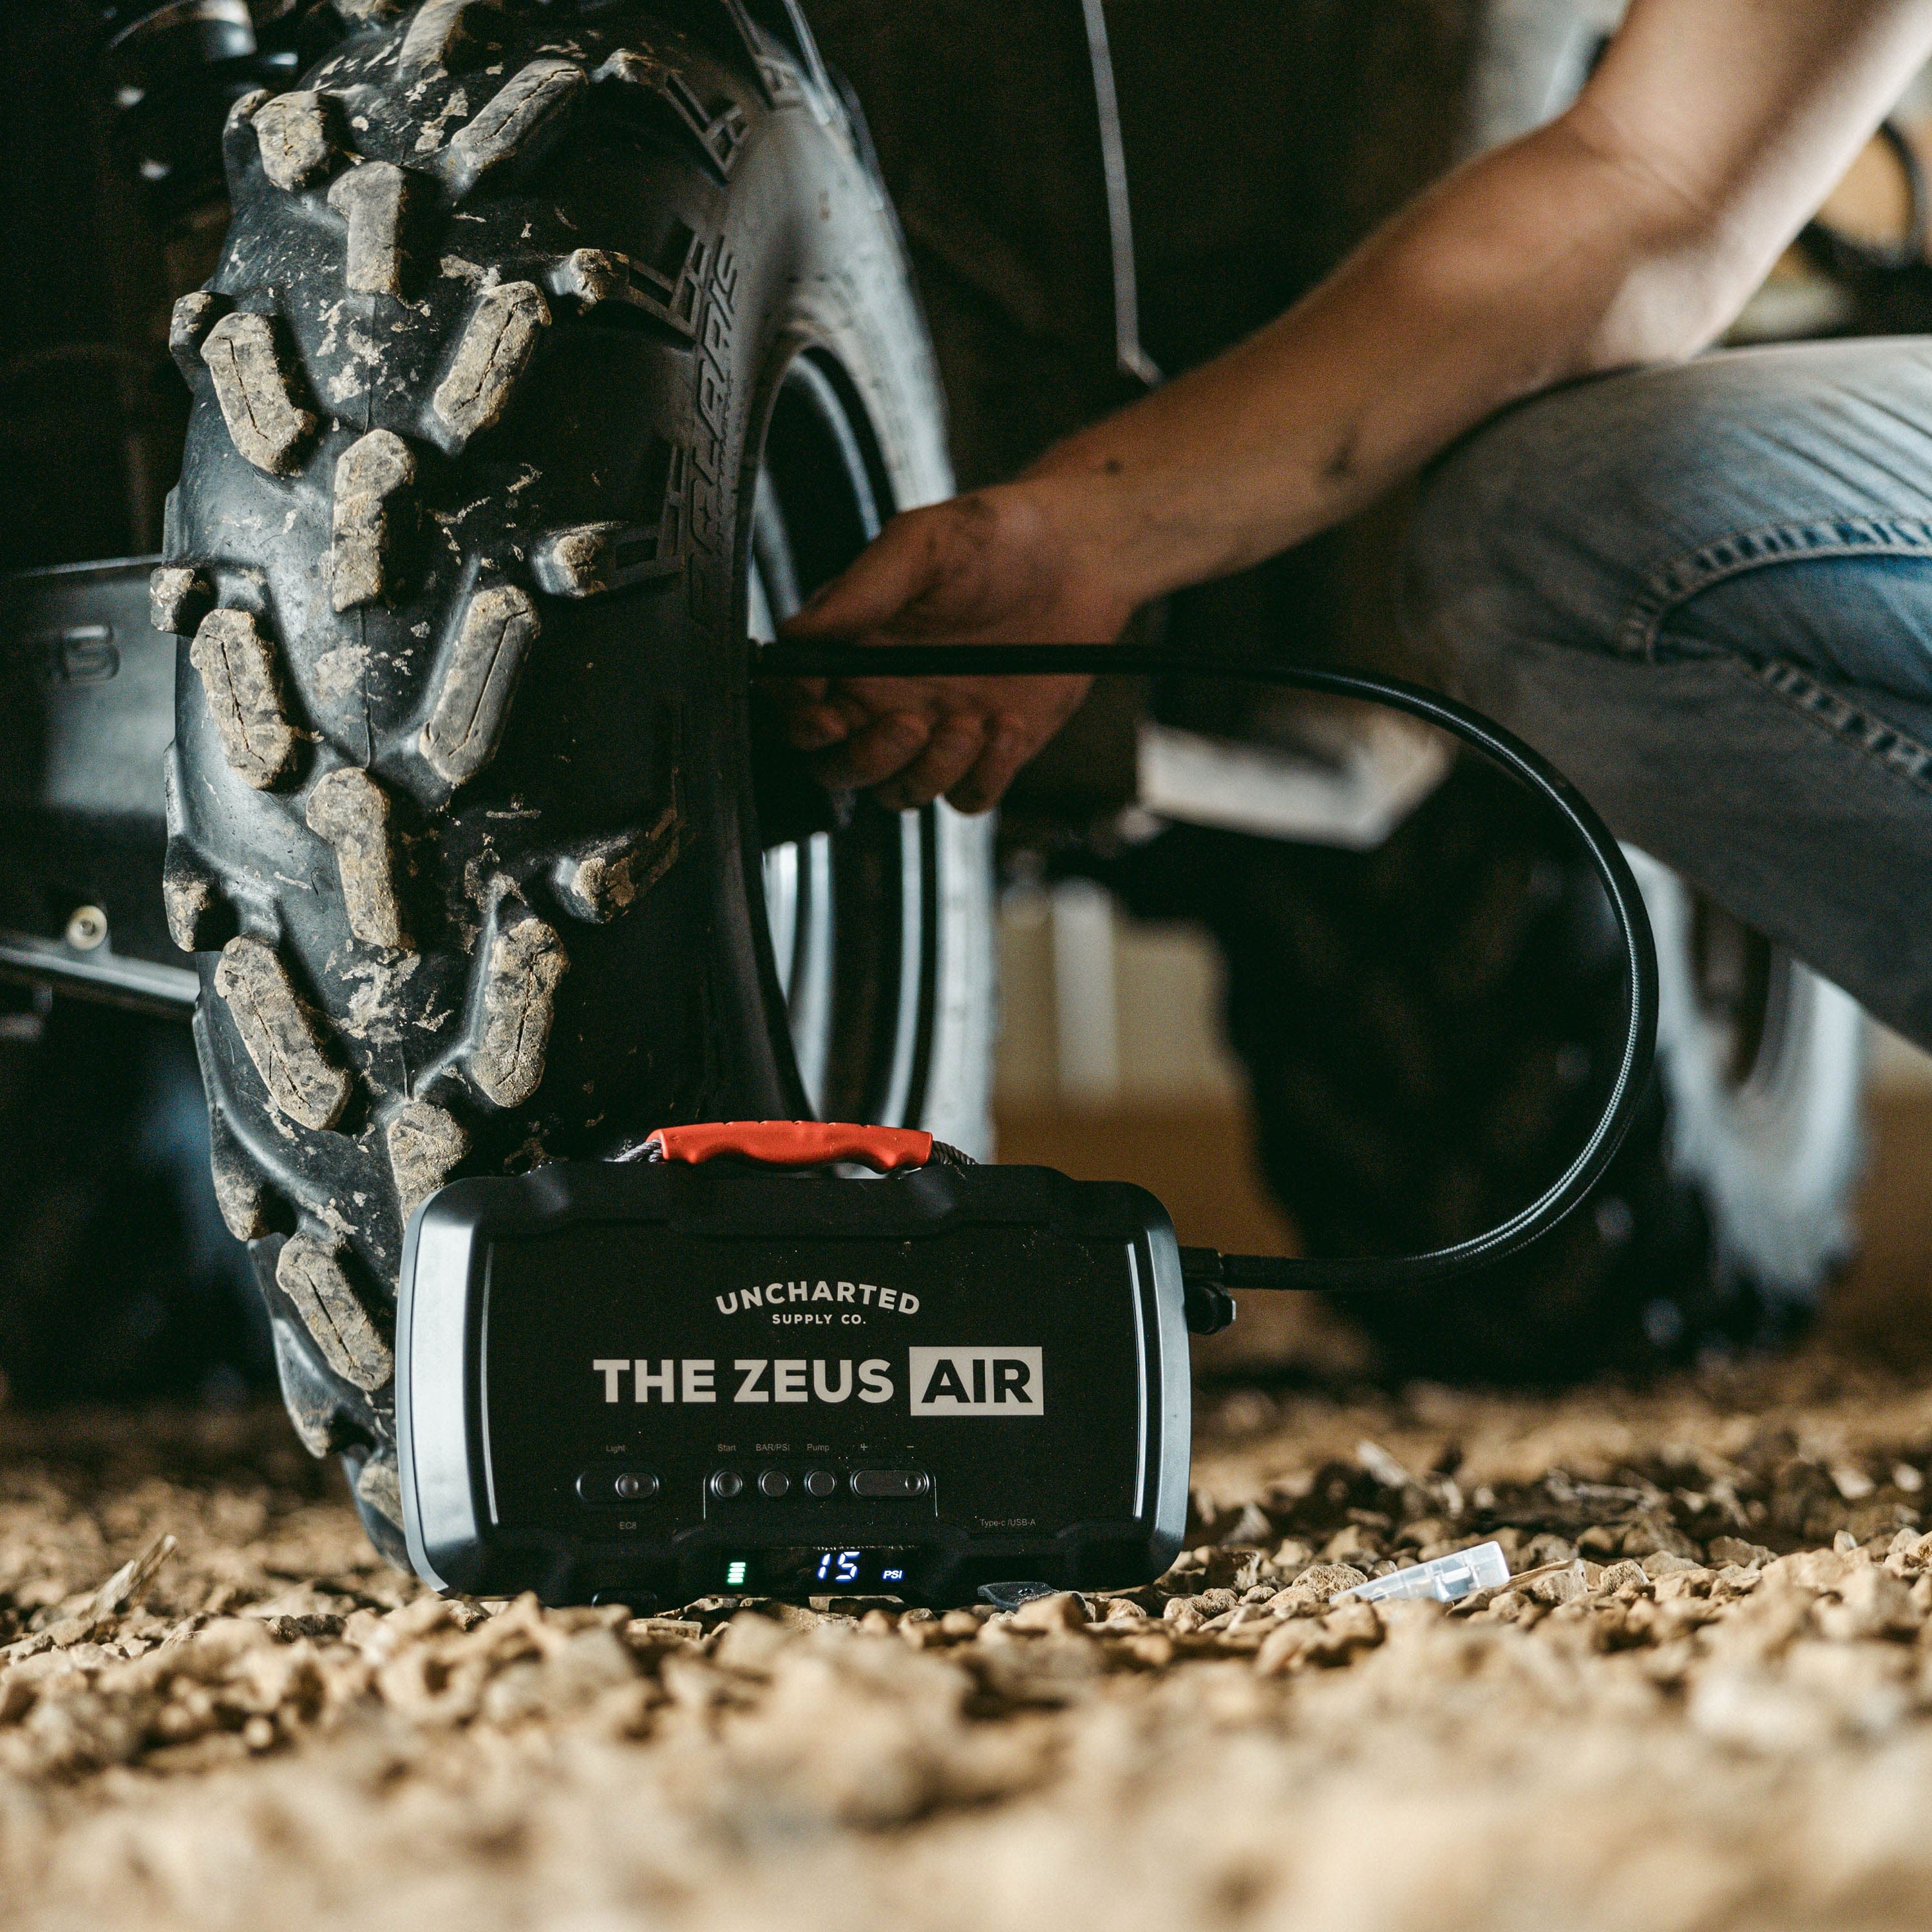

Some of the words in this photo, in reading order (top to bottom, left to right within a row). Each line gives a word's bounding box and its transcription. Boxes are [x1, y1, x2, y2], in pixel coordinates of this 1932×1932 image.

[715, 1280, 920, 1315] UNCHARTED
[772, 1314, 833, 1325] SUPPLY
[841, 1314, 866, 1325] CO.
[592, 1359, 717, 1403] THE
[734, 1358, 895, 1403] ZEUS
[921, 1359, 1033, 1403] AIR
[606, 1444, 625, 1454] Light
[717, 1443, 736, 1452] Start
[755, 1443, 790, 1452] BAR/PSI
[806, 1443, 830, 1453] Pump
[1007, 1518, 1036, 1527] /USB-A
[817, 1551, 860, 1580] 15
[882, 1569, 904, 1580] PSI
